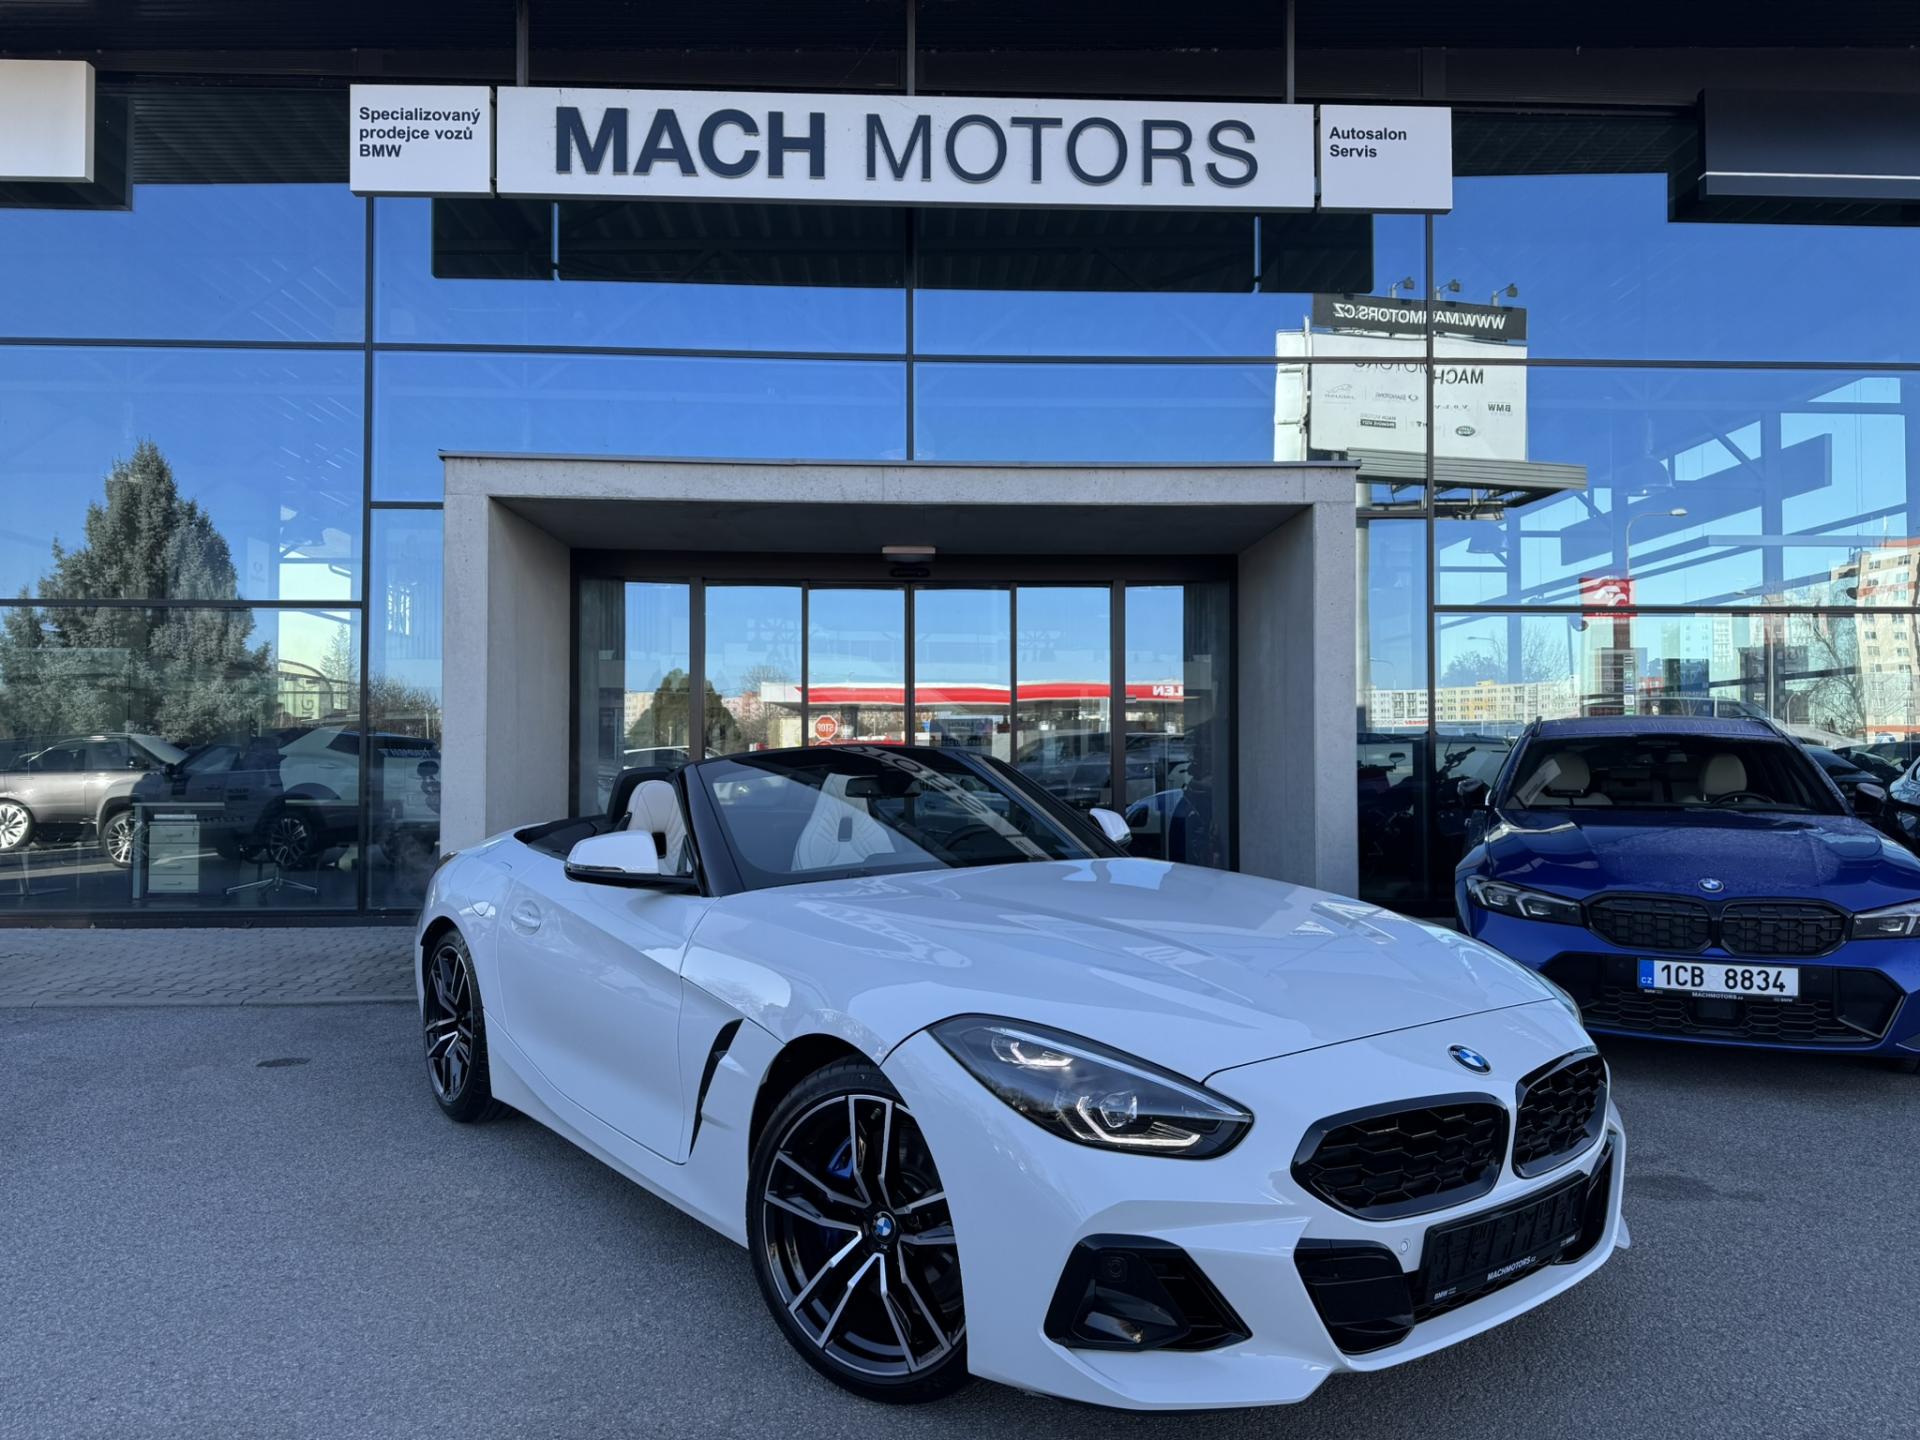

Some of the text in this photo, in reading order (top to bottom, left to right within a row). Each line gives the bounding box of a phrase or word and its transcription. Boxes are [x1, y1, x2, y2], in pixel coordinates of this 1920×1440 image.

[359, 106, 481, 124] Specializovaný
[359, 125, 473, 143] prodejce vozů
[1329, 126, 1407, 141] Autosalon
[359, 143, 402, 158] BMW
[555, 106, 1260, 188] MACH MOTORS
[1329, 144, 1378, 158] Servis
[1661, 964, 1786, 992] 1CB 8834
